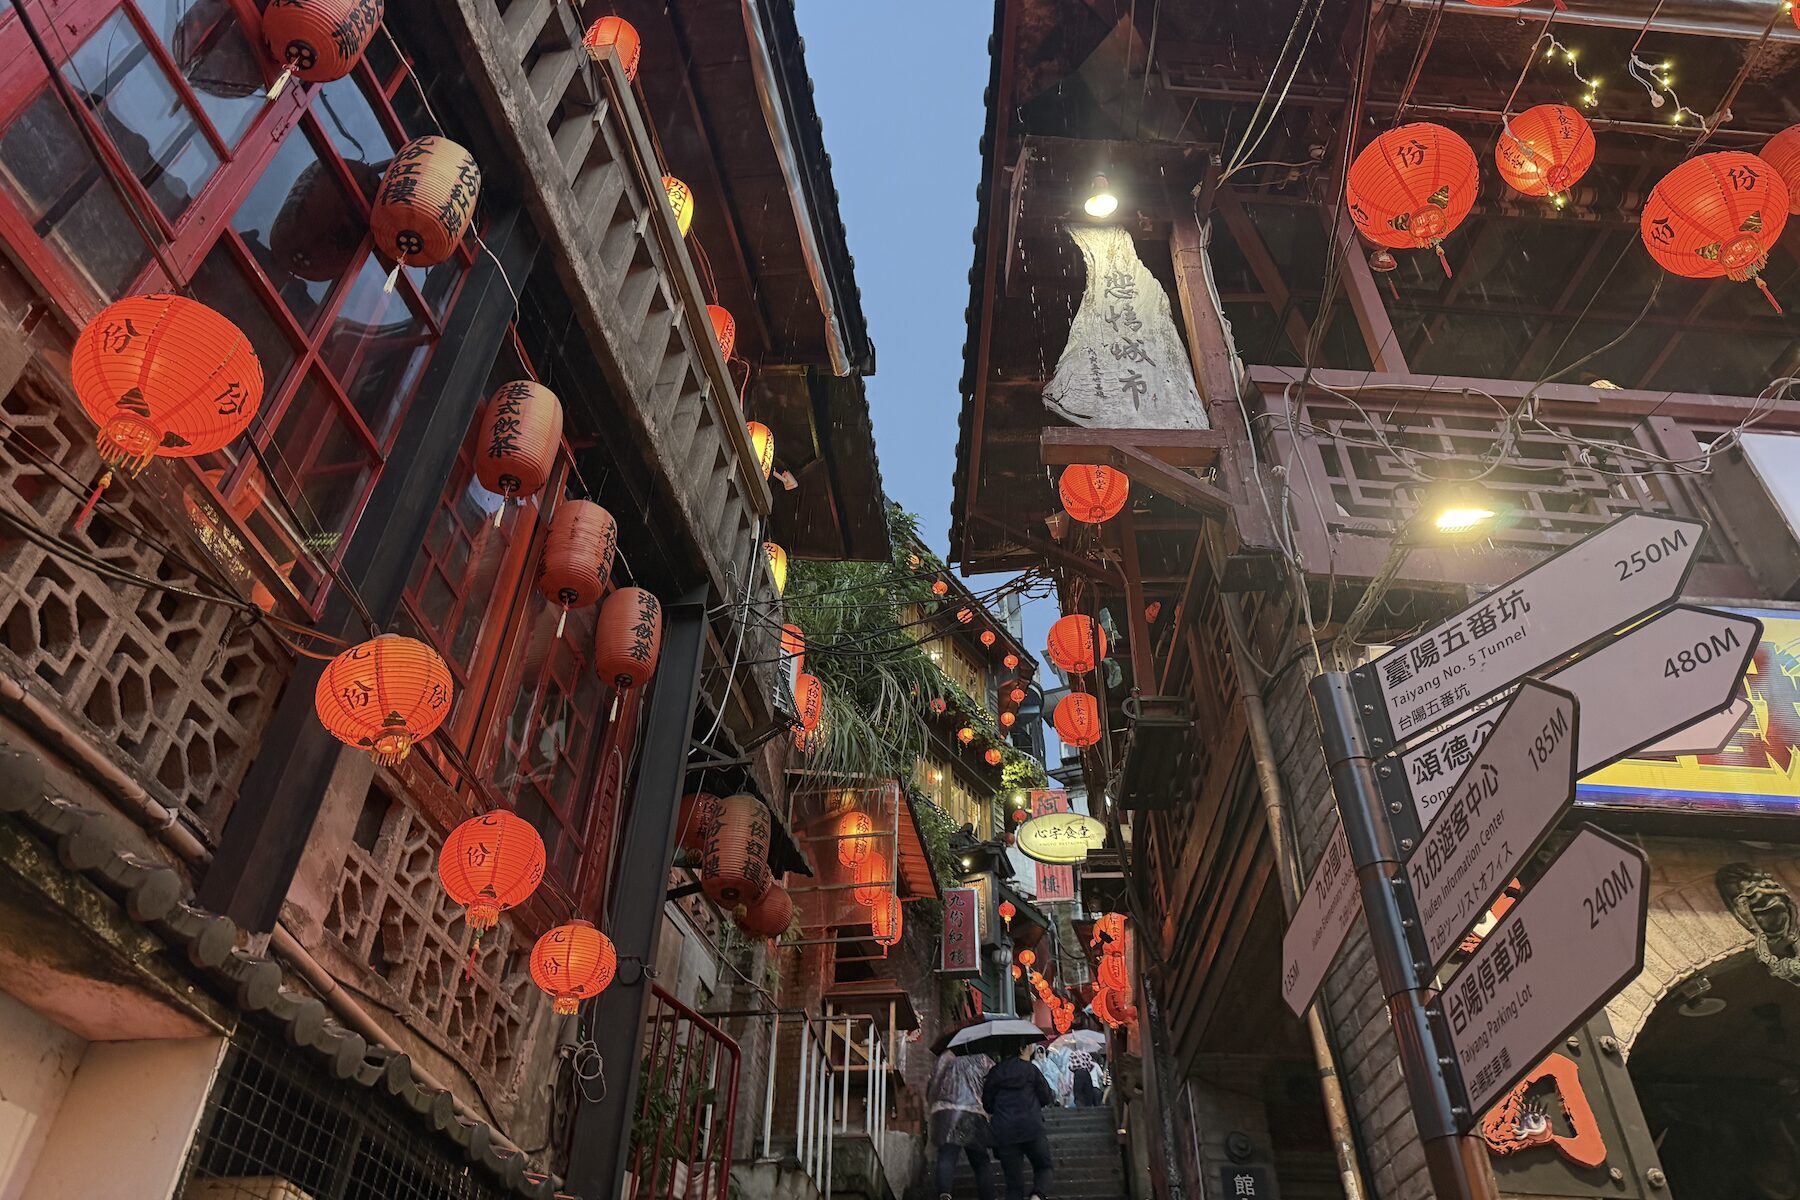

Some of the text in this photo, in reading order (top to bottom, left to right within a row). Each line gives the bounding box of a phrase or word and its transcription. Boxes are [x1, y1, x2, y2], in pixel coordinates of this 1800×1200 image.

[1396, 139, 1429, 168] 份
[1727, 165, 1760, 192] 份
[488, 382, 535, 459] 港式飲茶
[1614, 529, 1688, 581] 250M
[630, 591, 659, 663] 港式飲茶
[1383, 589, 1531, 690] 臺陽五番坑
[1664, 627, 1741, 680] 480M
[1391, 676, 1441, 708] Taiyang
[1443, 664, 1466, 681] No.
[1468, 654, 1476, 667] 5
[1478, 626, 1527, 661] Tunnel
[1398, 683, 1471, 732] 台陽五番坑
[1527, 707, 1569, 773] 185M
[1412, 763, 1499, 900] 九份遊客中心
[1422, 808, 1506, 926] Jiufen Information Center
[1583, 860, 1635, 930] 240M
[1449, 917, 1533, 1037] 台陽停車場
[1460, 983, 1533, 1067] Taiyang Parking Lot
[1233, 1174, 1256, 1200] 館
